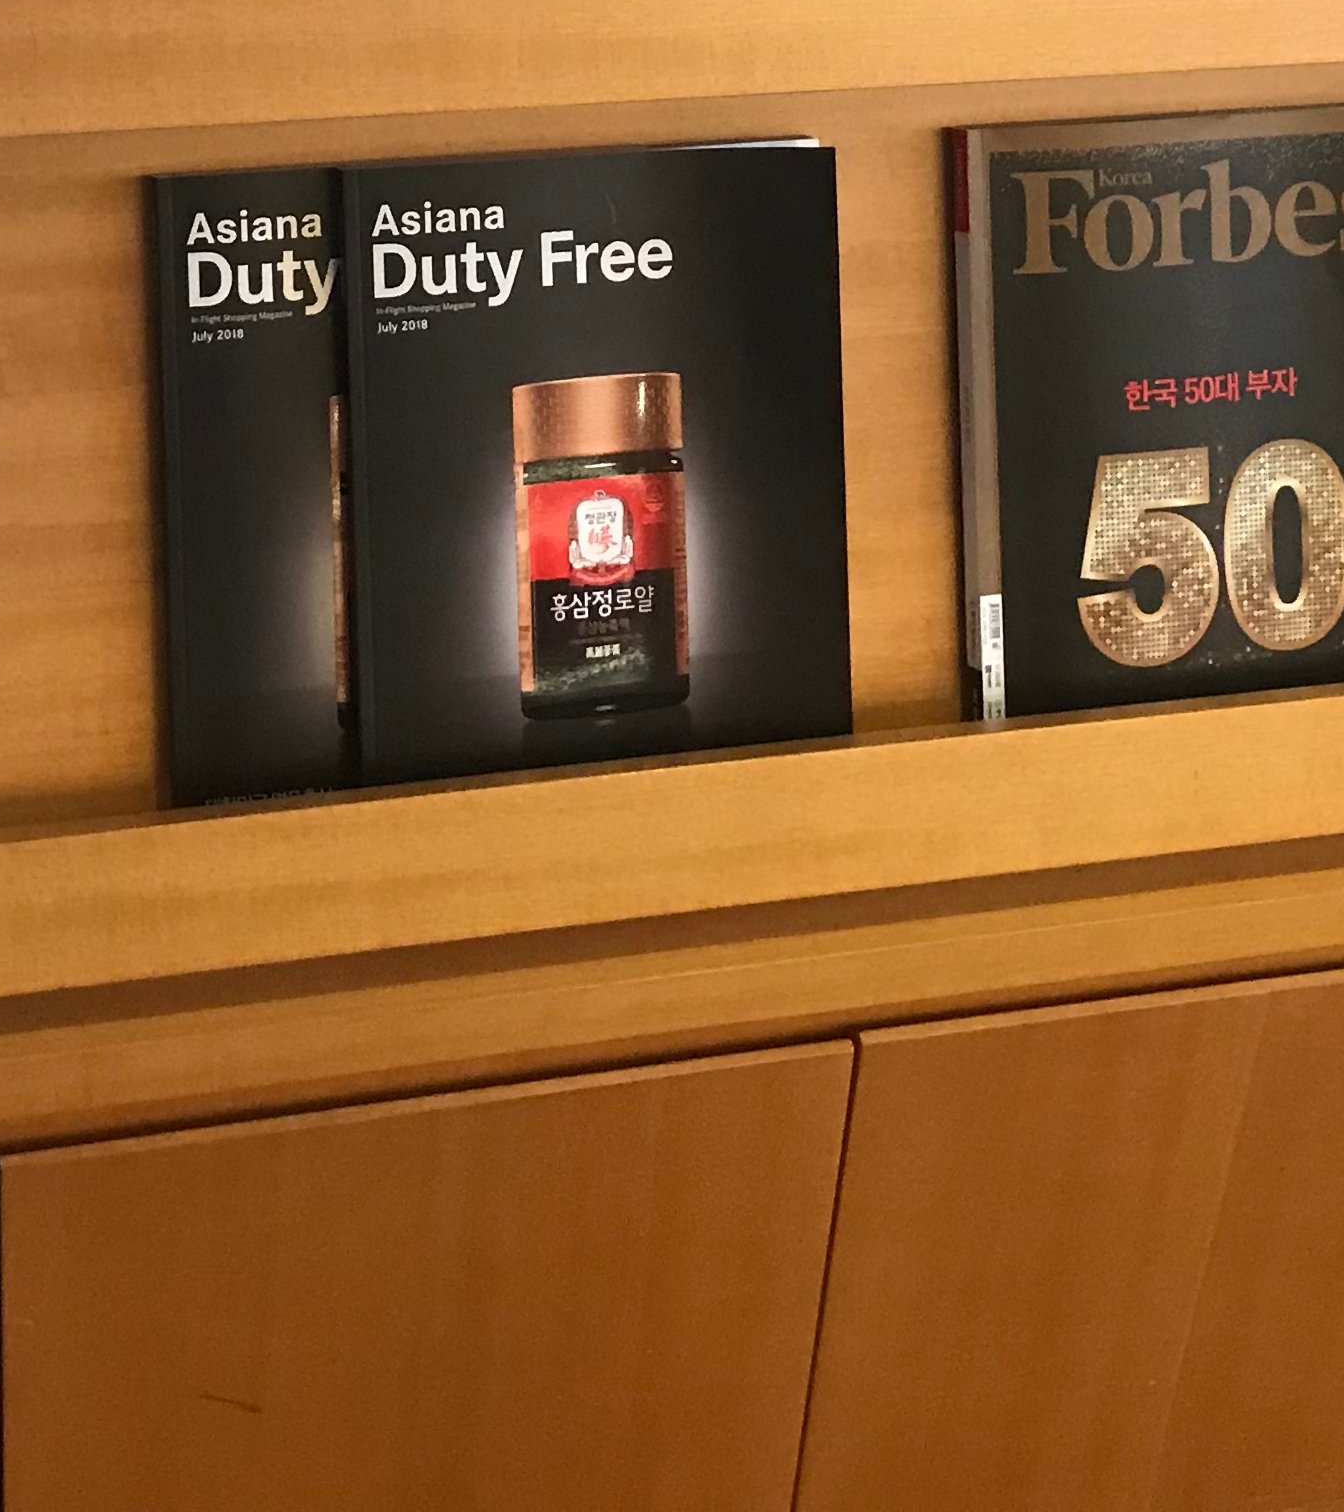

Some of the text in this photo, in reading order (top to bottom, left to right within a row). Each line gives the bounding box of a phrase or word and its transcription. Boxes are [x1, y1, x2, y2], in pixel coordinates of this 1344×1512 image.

[1098, 167, 1153, 187] Korea
[186, 210, 324, 246] Asiana
[371, 201, 506, 238] Asiana
[187, 249, 340, 317] Duty
[372, 229, 674, 308] Duty Free
[192, 328, 244, 343] July 2018
[377, 318, 428, 335] July 2018
[1124, 367, 1298, 412] 한국 50대 부자
[550, 585, 655, 622] 홍삼정로얄
